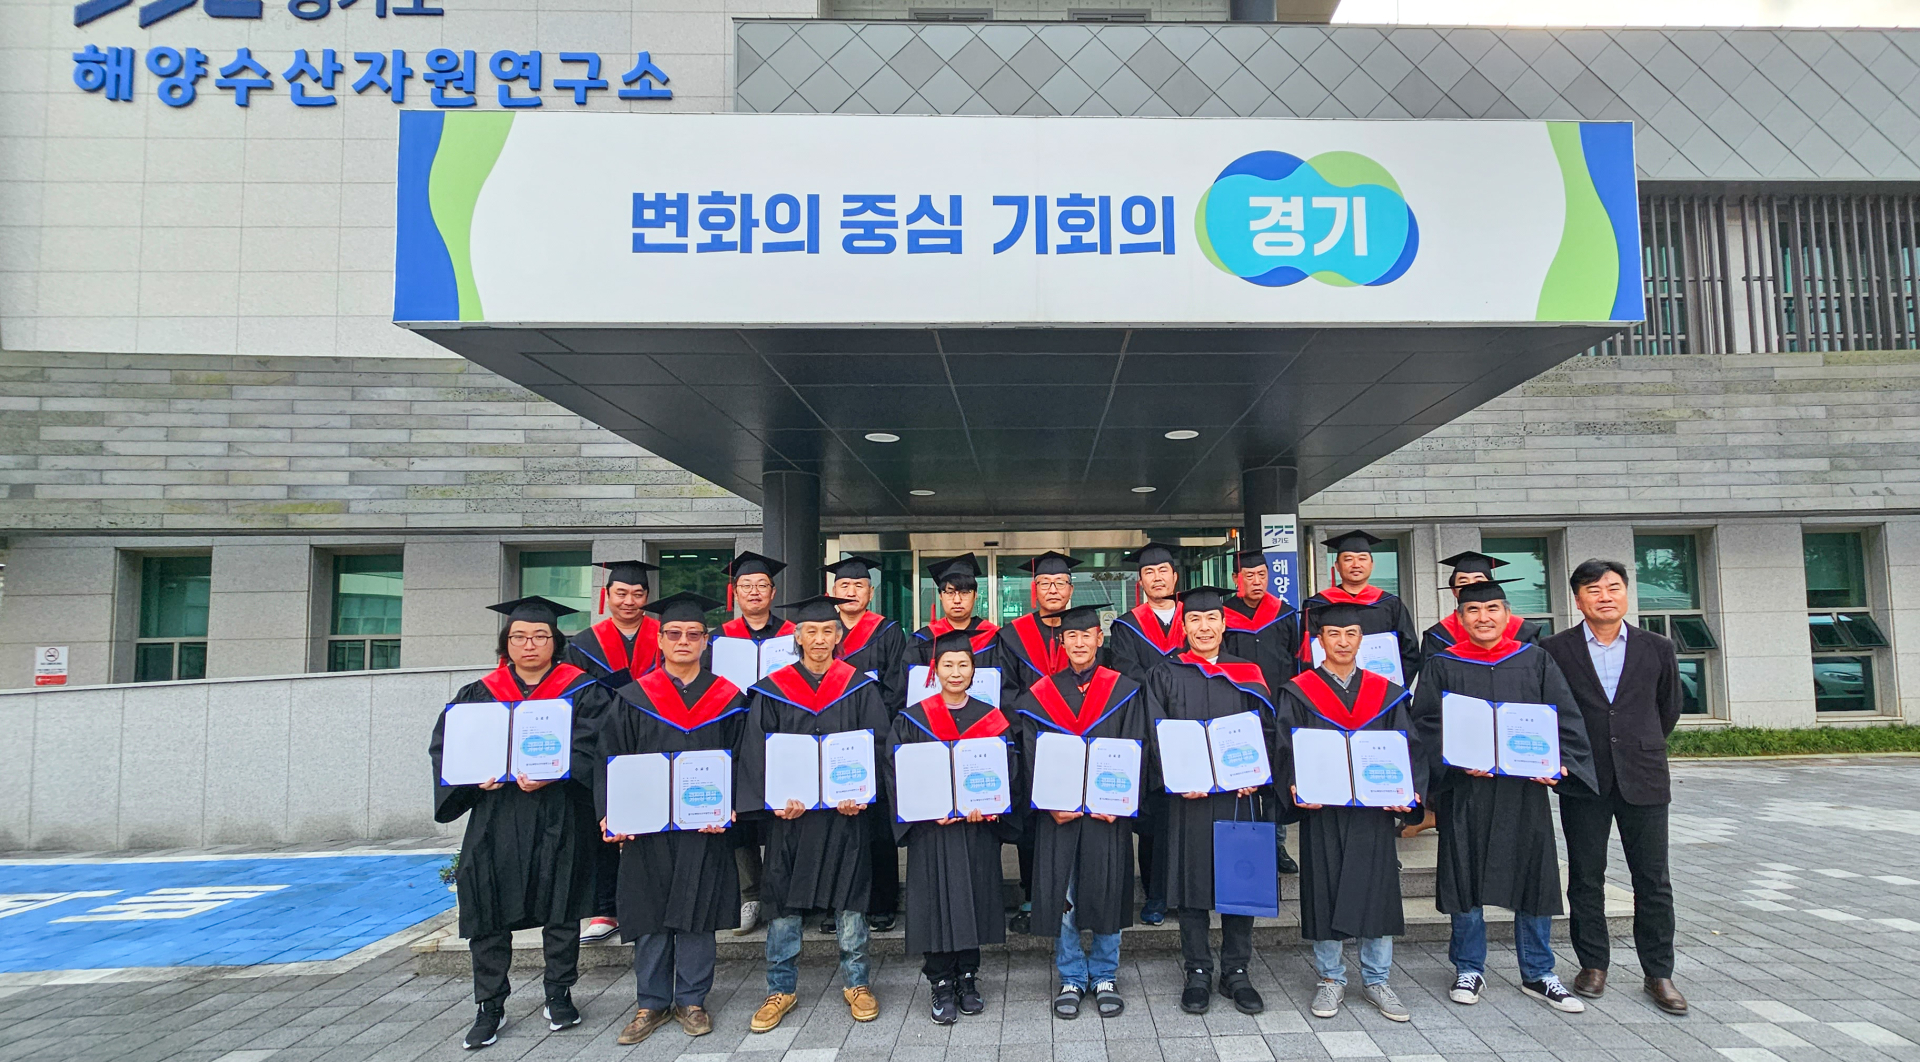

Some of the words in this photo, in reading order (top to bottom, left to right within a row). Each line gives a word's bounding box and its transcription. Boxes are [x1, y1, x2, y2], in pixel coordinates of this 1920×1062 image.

[73, 44, 673, 107] 해양수산자원연구소
[632, 191, 819, 254] 변화의
[840, 193, 962, 254] 중심
[993, 193, 1175, 254] 기회의
[1249, 197, 1367, 256] 경기
